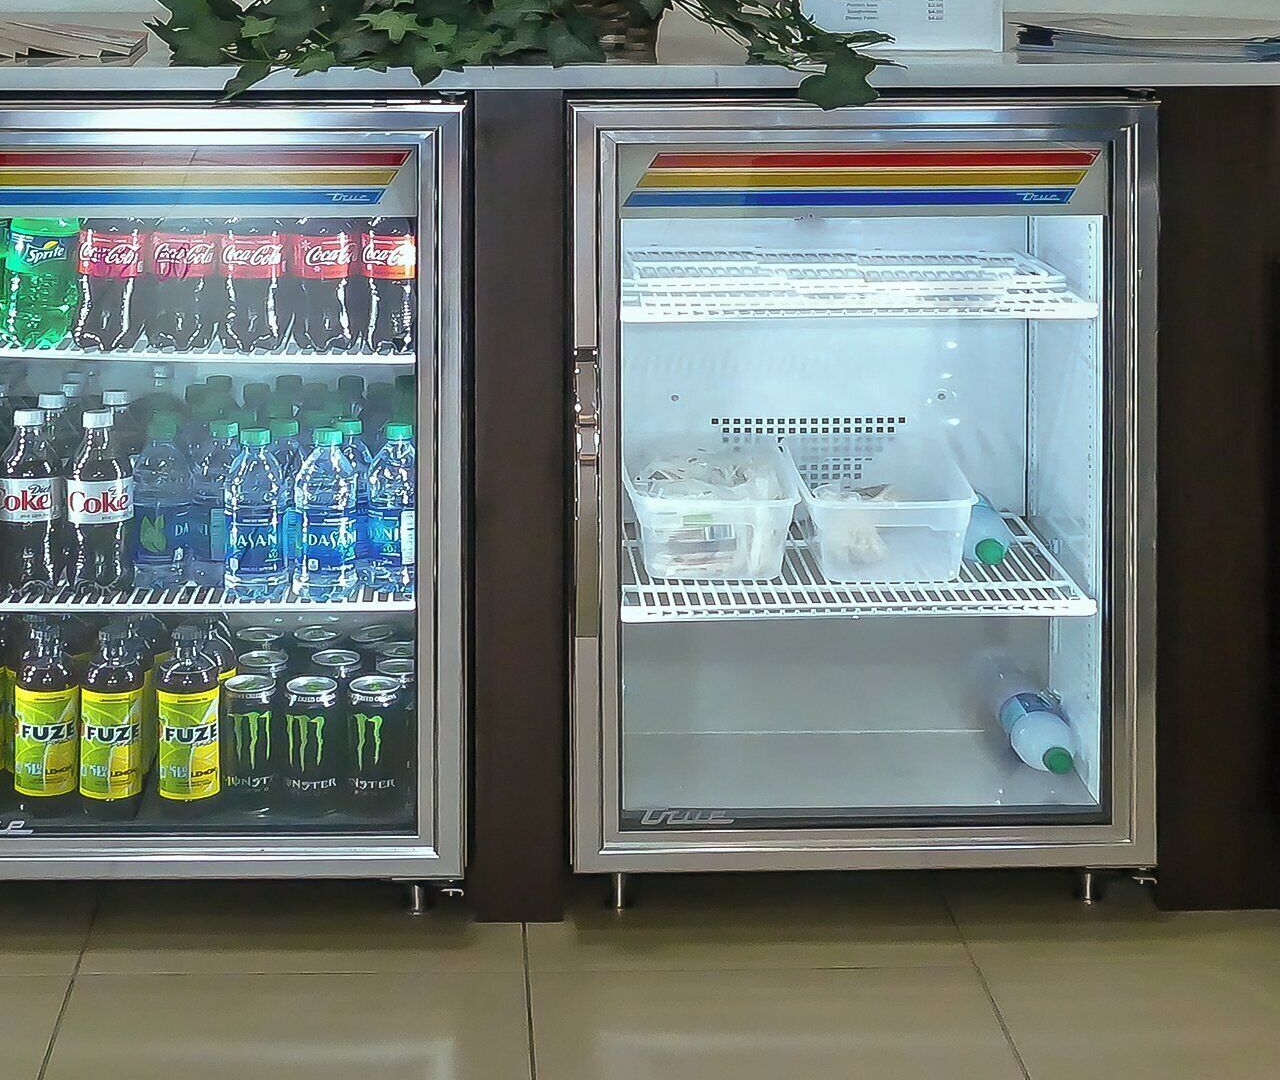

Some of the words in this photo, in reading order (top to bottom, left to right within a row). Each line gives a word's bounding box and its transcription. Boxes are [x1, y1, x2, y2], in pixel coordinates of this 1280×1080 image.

[28, 245, 65, 263] Sprite
[222, 242, 284, 266] Coca-Cola
[70, 490, 130, 514] Coke
[21, 722, 75, 741] FUZE
[86, 722, 140, 743] FUZE
[165, 723, 218, 743] FUZE
